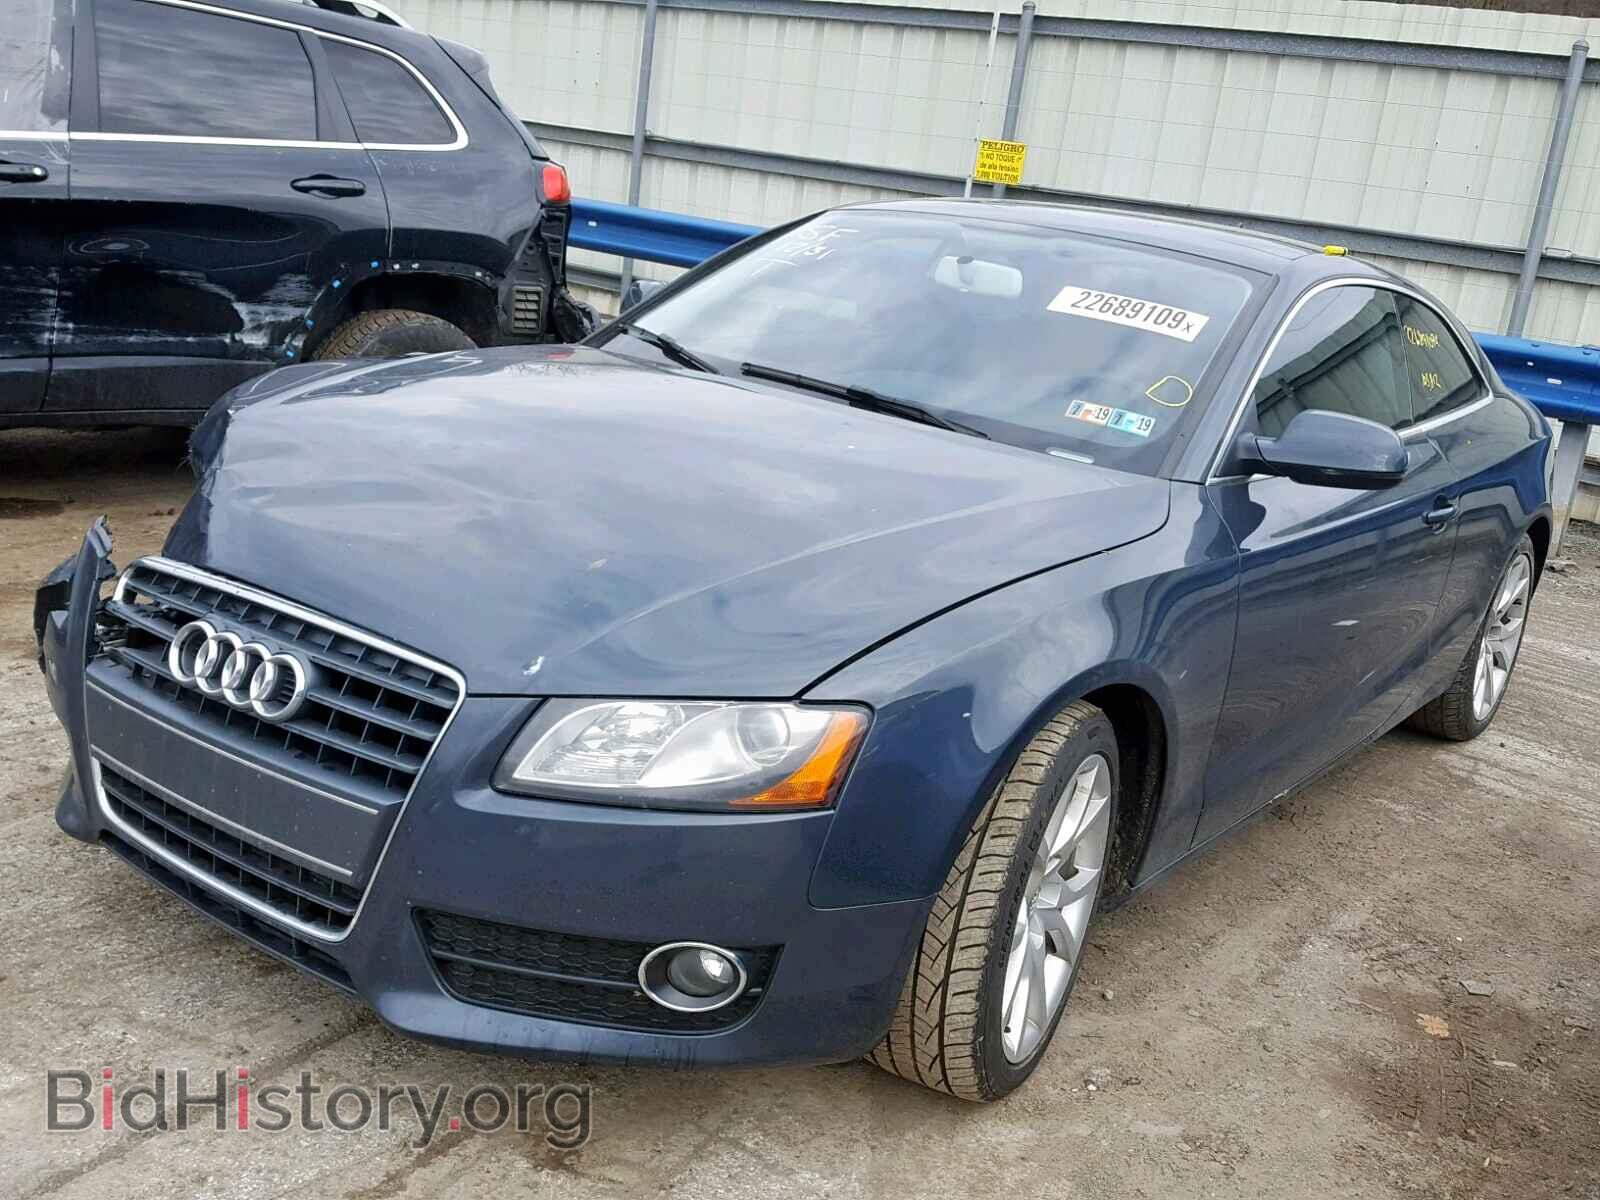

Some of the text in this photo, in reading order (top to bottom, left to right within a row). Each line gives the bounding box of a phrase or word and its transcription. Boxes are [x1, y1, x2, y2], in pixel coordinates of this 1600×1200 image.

[981, 140, 1025, 154] PELIGRO
[985, 152, 1017, 163] NO TOQUE
[1095, 407, 1110, 421] 19
[1136, 417, 1152, 431] 19
